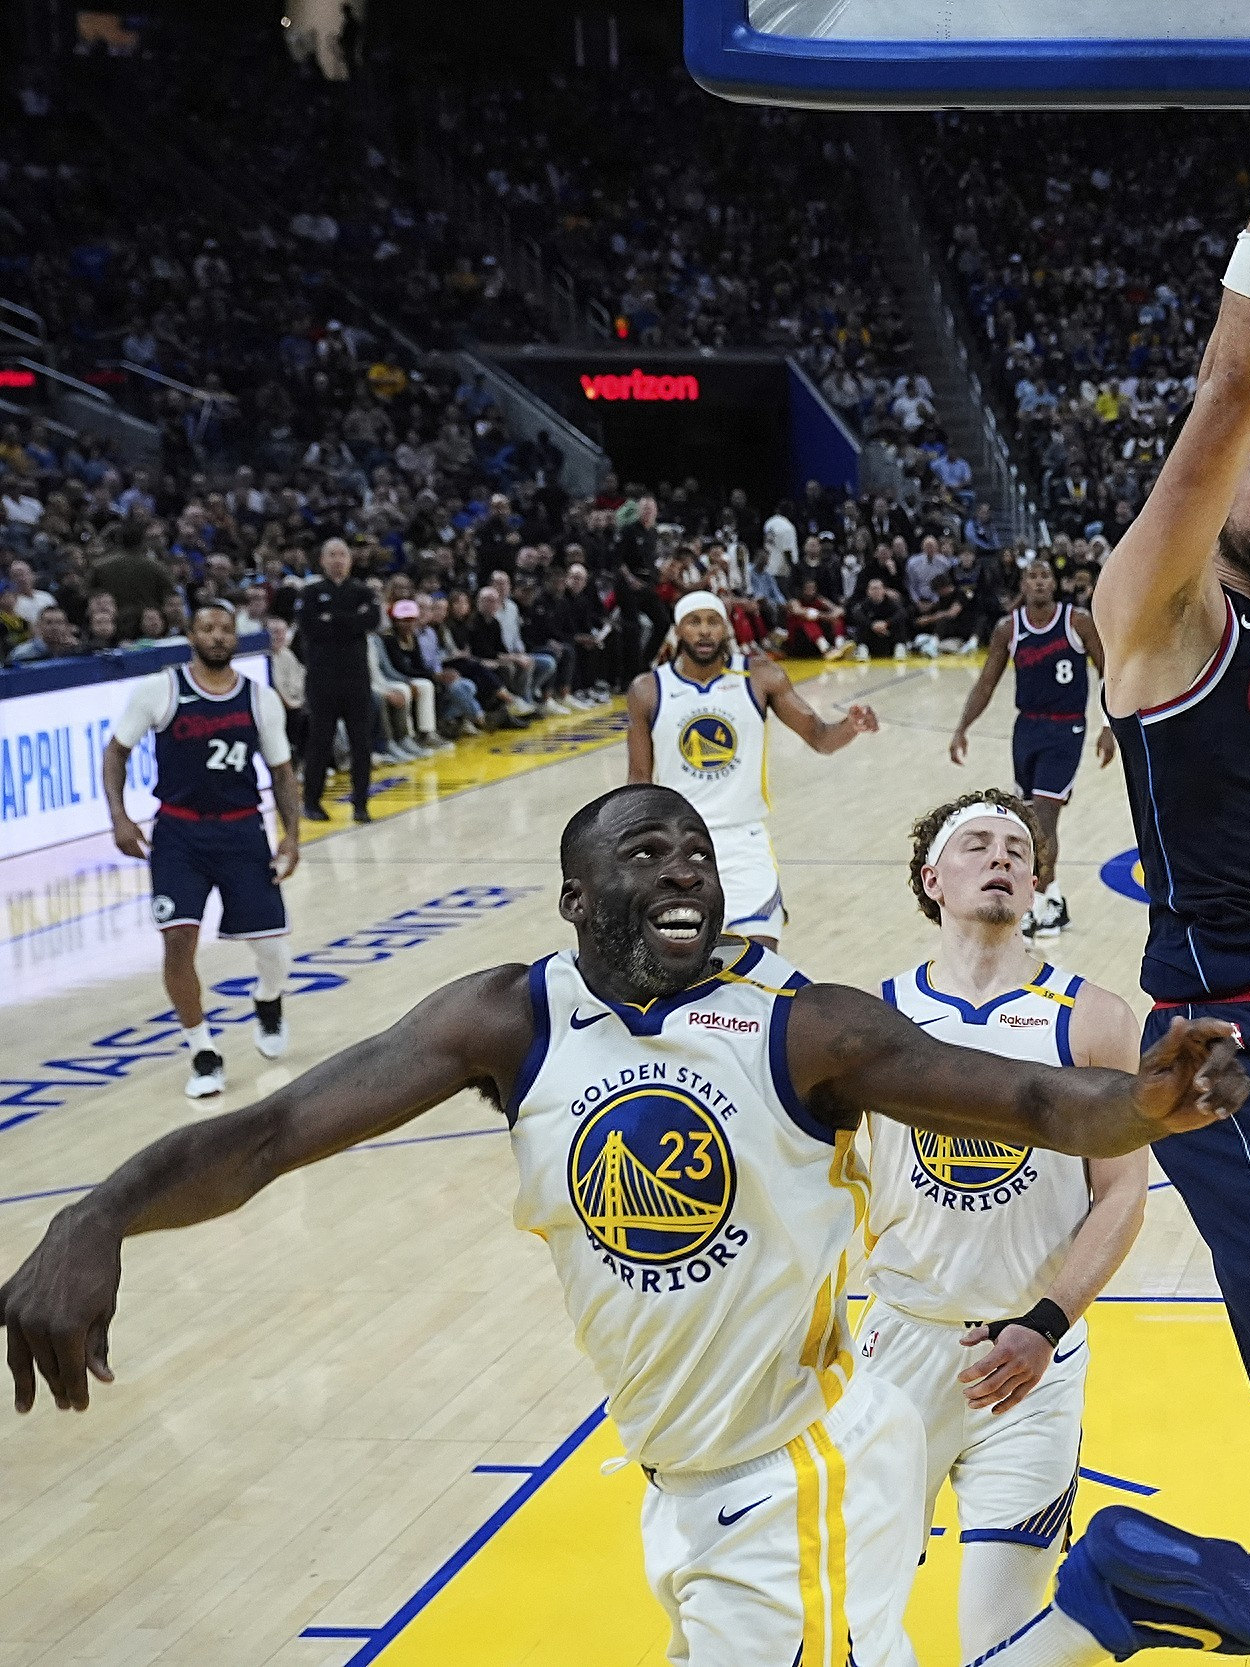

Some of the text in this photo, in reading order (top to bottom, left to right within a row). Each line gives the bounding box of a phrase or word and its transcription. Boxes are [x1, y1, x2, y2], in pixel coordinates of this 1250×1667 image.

[580, 368, 699, 400] verizon
[1055, 659, 1074, 684] 8
[206, 738, 249, 773] 24
[2, 727, 81, 820] APRIL
[689, 1012, 760, 1033] Rakuten
[1000, 1013, 1049, 1026] Rakuten
[571, 1062, 738, 1121] GOLDEN STATE
[656, 1130, 713, 1180] 23
[910, 1164, 1038, 1212] WARRIORS
